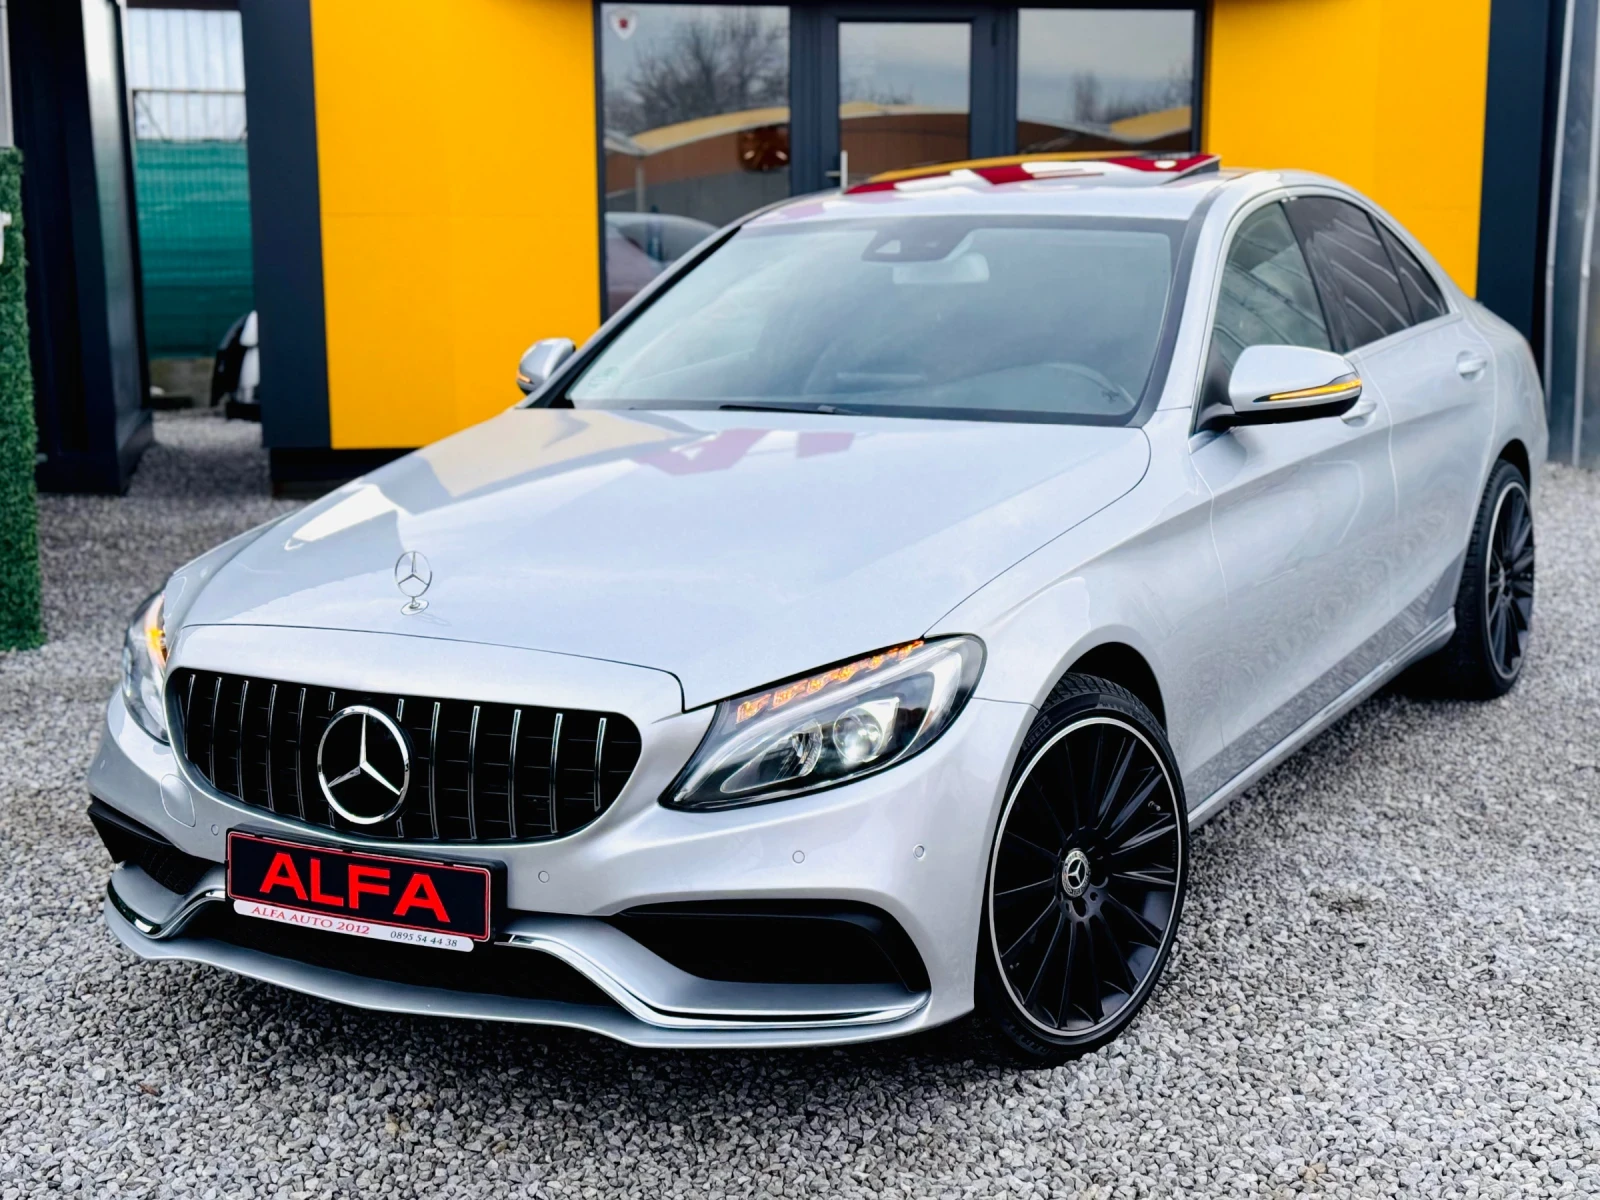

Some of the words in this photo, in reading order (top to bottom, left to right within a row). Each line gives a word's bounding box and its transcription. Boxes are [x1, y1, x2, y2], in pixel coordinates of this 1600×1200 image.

[259, 852, 451, 923] ALFA
[251, 906, 286, 920] ALFA
[290, 913, 333, 928] AUTO
[336, 921, 370, 935] 2012
[390, 930, 414, 941] 0895
[416, 934, 428, 944] 54
[430, 937, 443, 945] 44
[445, 938, 458, 947] 38
